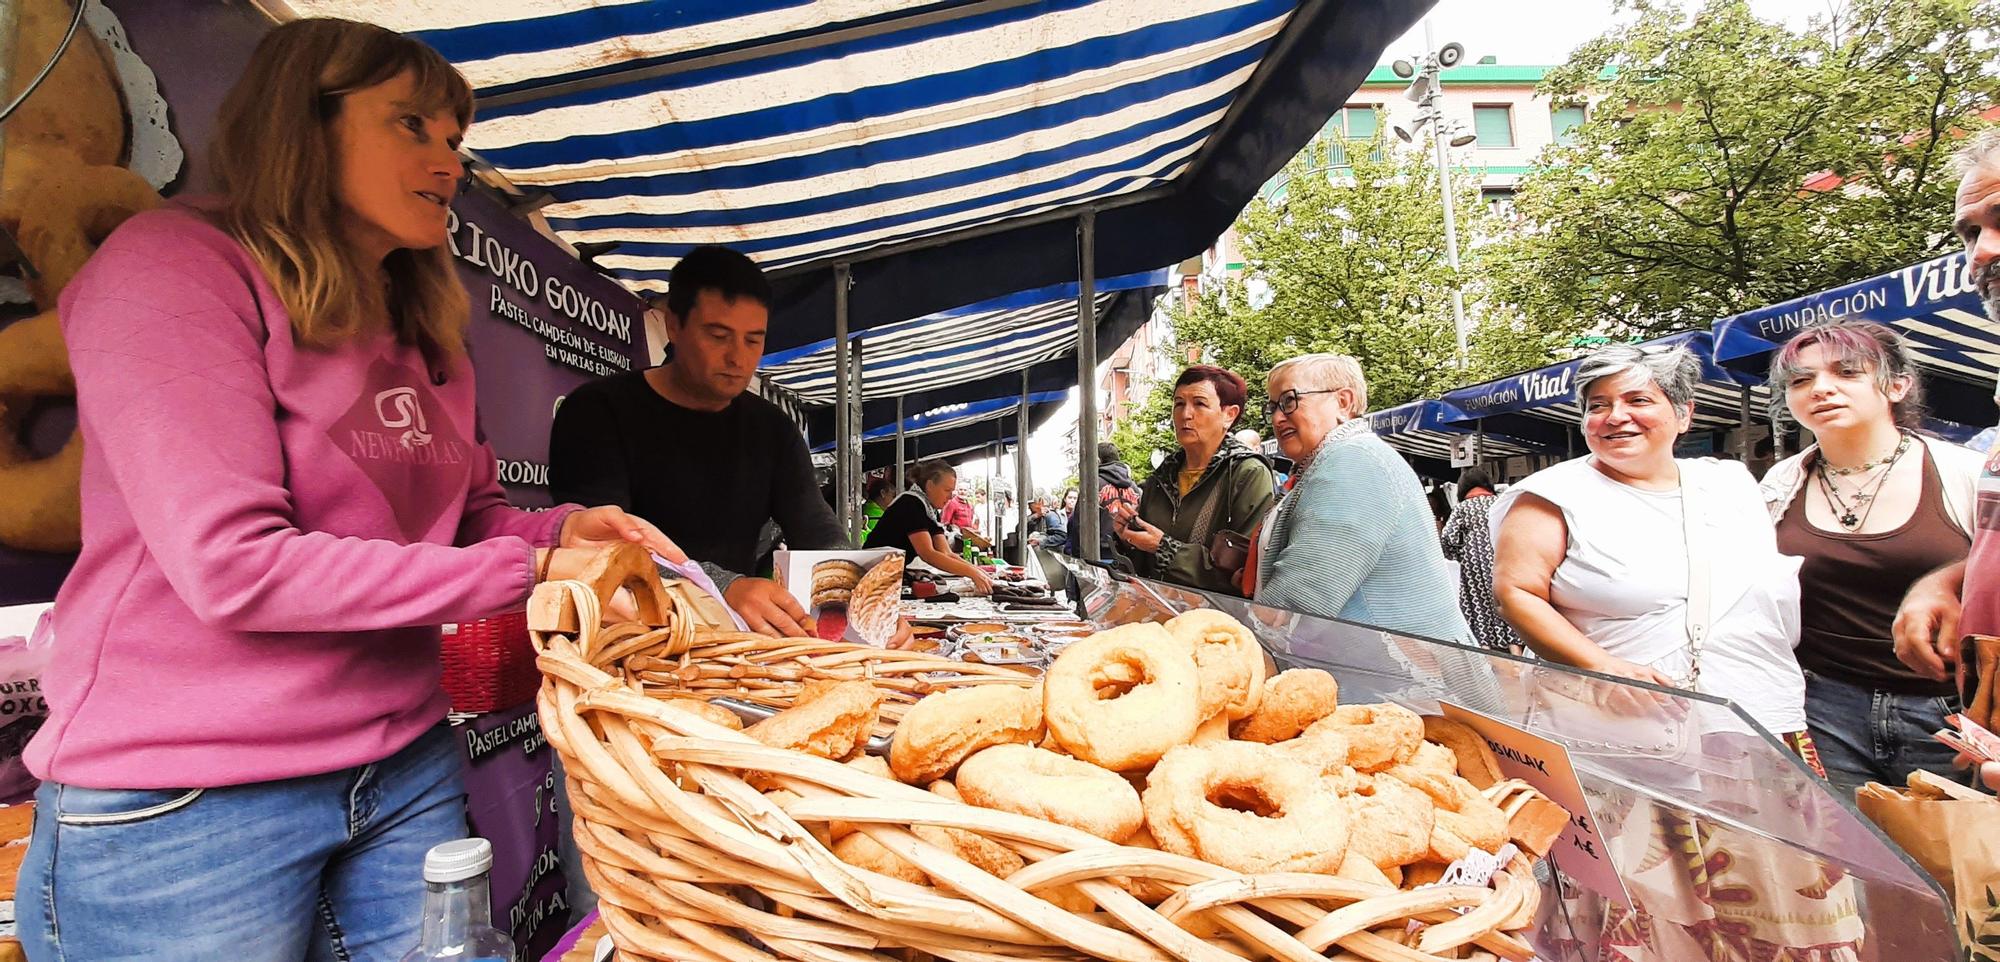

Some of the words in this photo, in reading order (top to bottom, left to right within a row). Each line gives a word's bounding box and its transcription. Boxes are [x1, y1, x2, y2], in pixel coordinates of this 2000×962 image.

[545, 276, 632, 345] GOXOAK
[1759, 288, 1887, 337] FUNDACIÓN
[1888, 251, 1977, 308] Vita
[490, 284, 532, 329] PASTEL
[532, 317, 582, 350] CAMPEÓN
[583, 337, 598, 356] DE
[598, 345, 632, 371] EUSKADI
[545, 343, 558, 360] EN
[558, 348, 595, 373] VARIAS
[1519, 366, 1571, 402] Vital
[466, 728, 510, 760] PASTEL
[509, 712, 539, 738] CAMP
